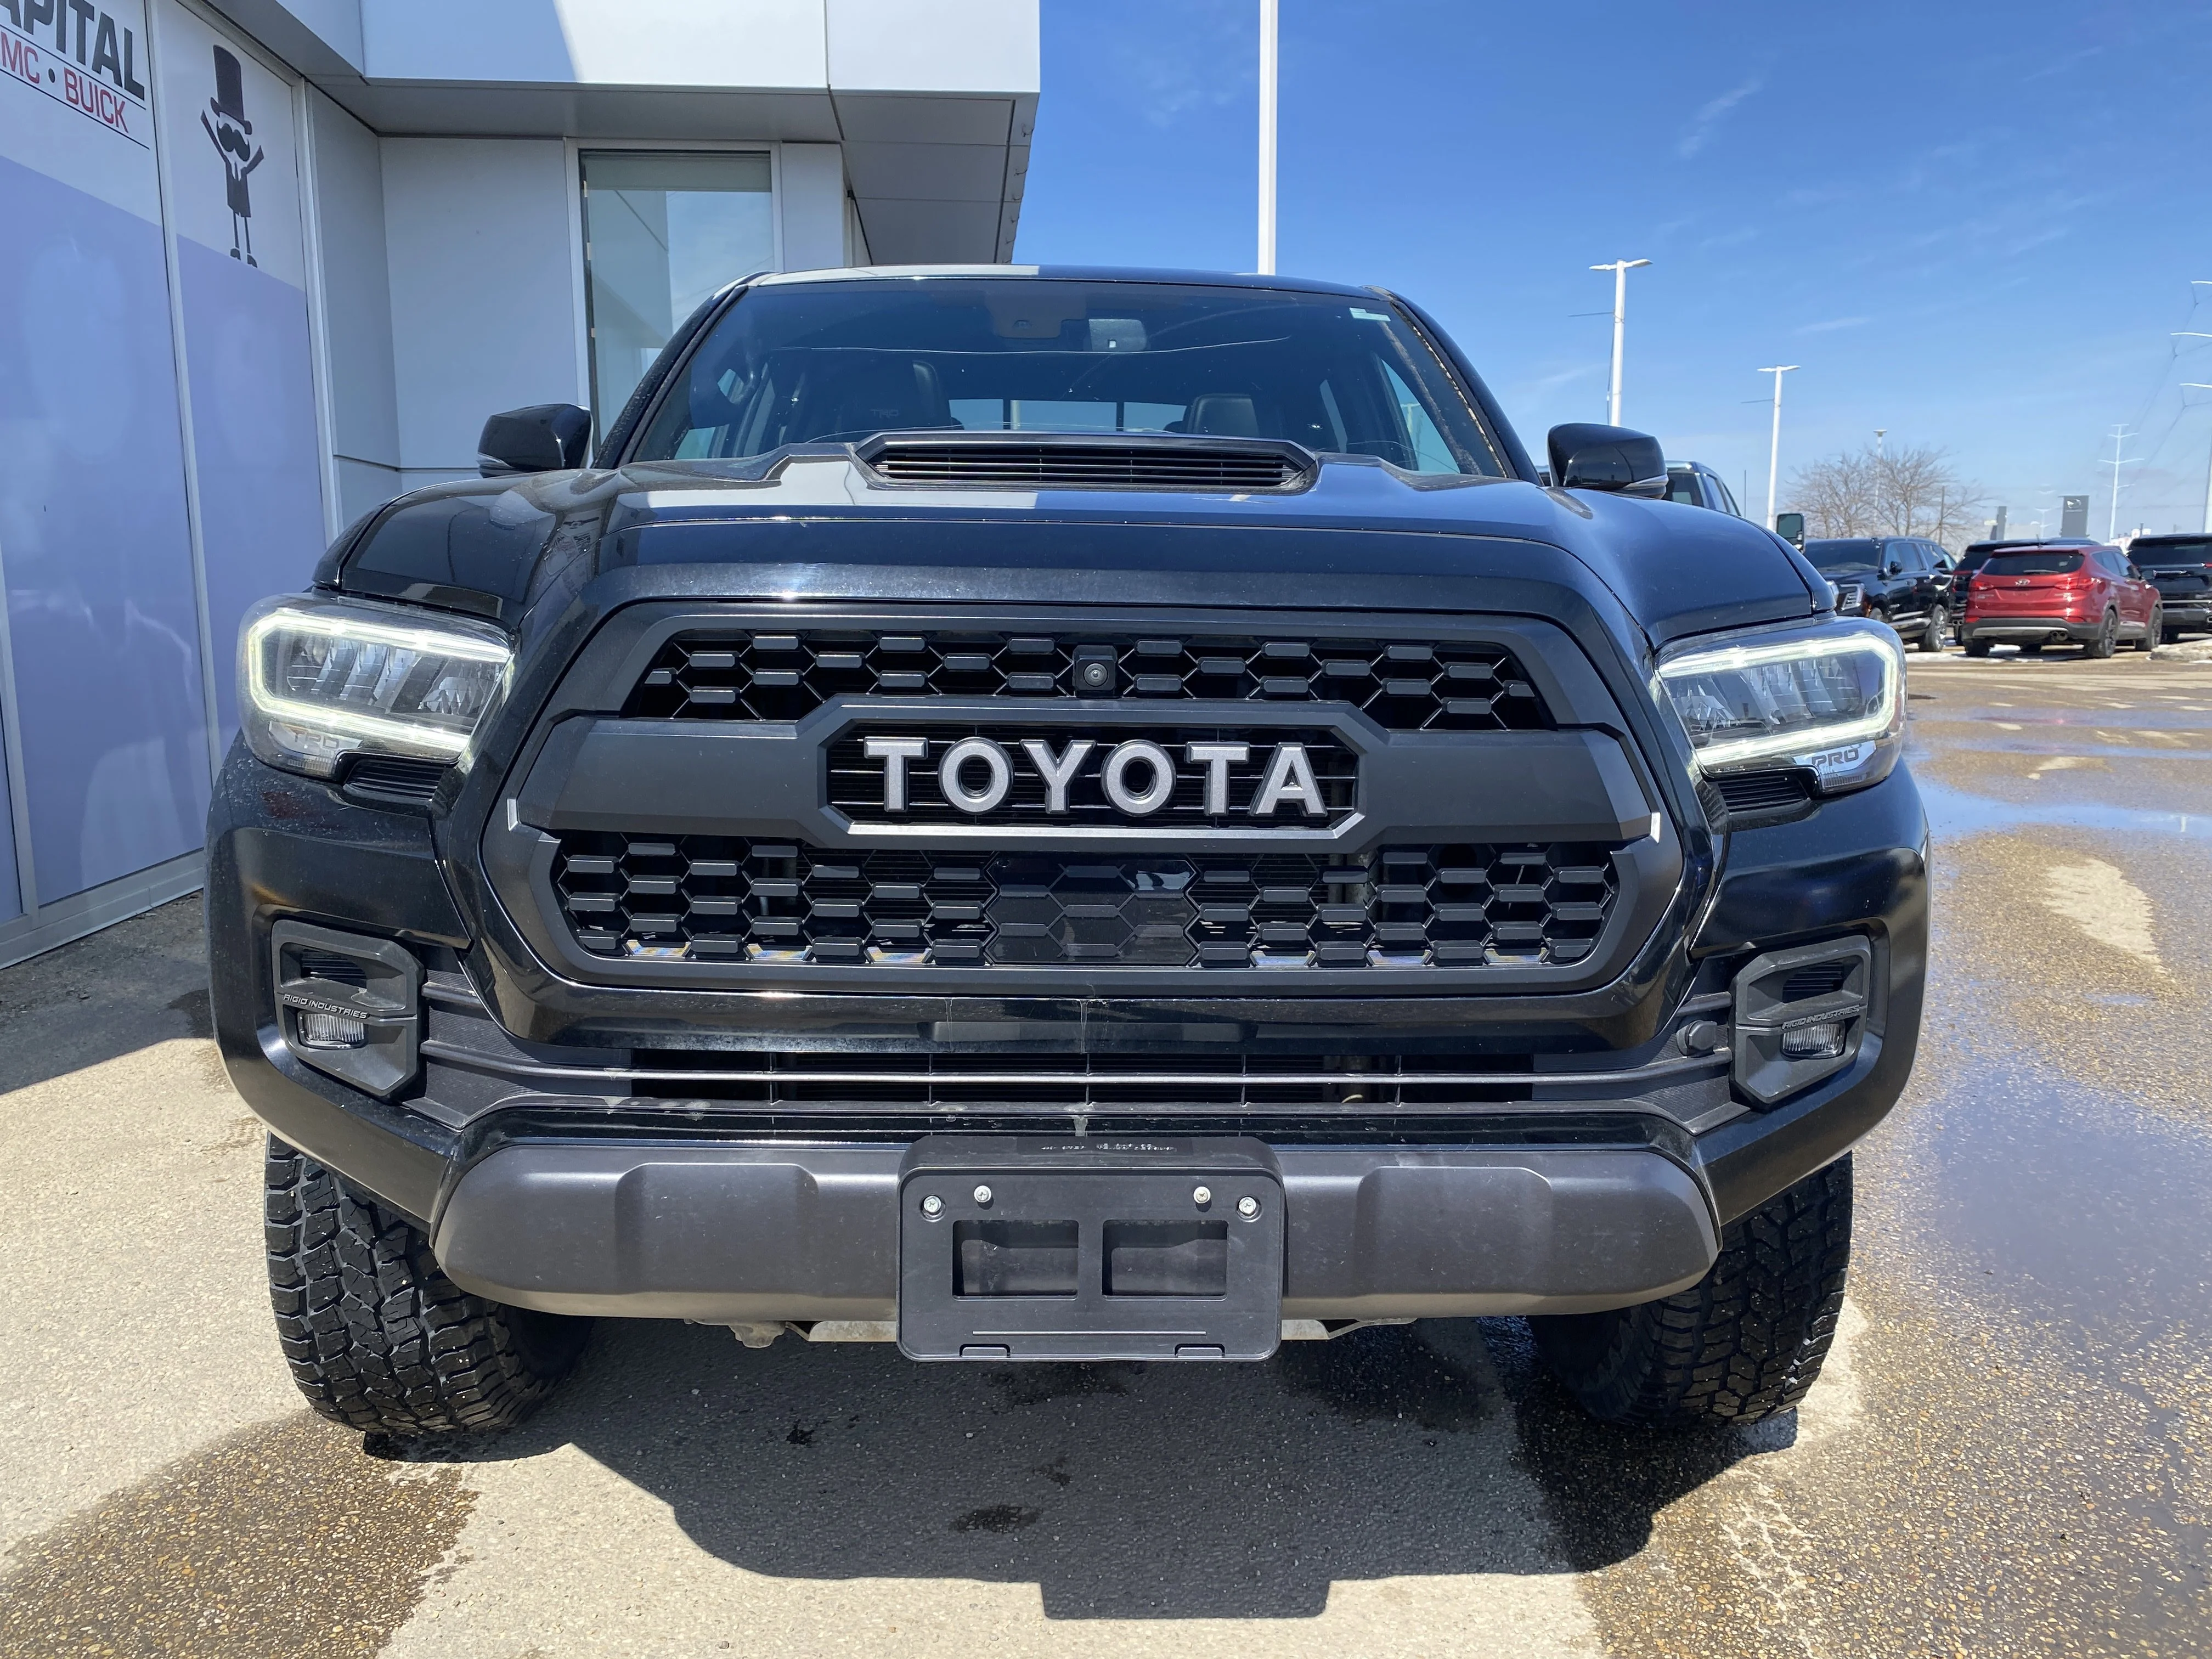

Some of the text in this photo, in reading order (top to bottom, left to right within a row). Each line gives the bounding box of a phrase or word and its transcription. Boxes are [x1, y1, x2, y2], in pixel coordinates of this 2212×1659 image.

[1, 31, 128, 133] MC BUICK
[1812, 748, 1859, 766] PRO
[864, 736, 1328, 817] TOYOTA
[283, 994, 369, 1019] RIGID INDUSTRIES
[1807, 1005, 1860, 1024] INDUSTRIES
